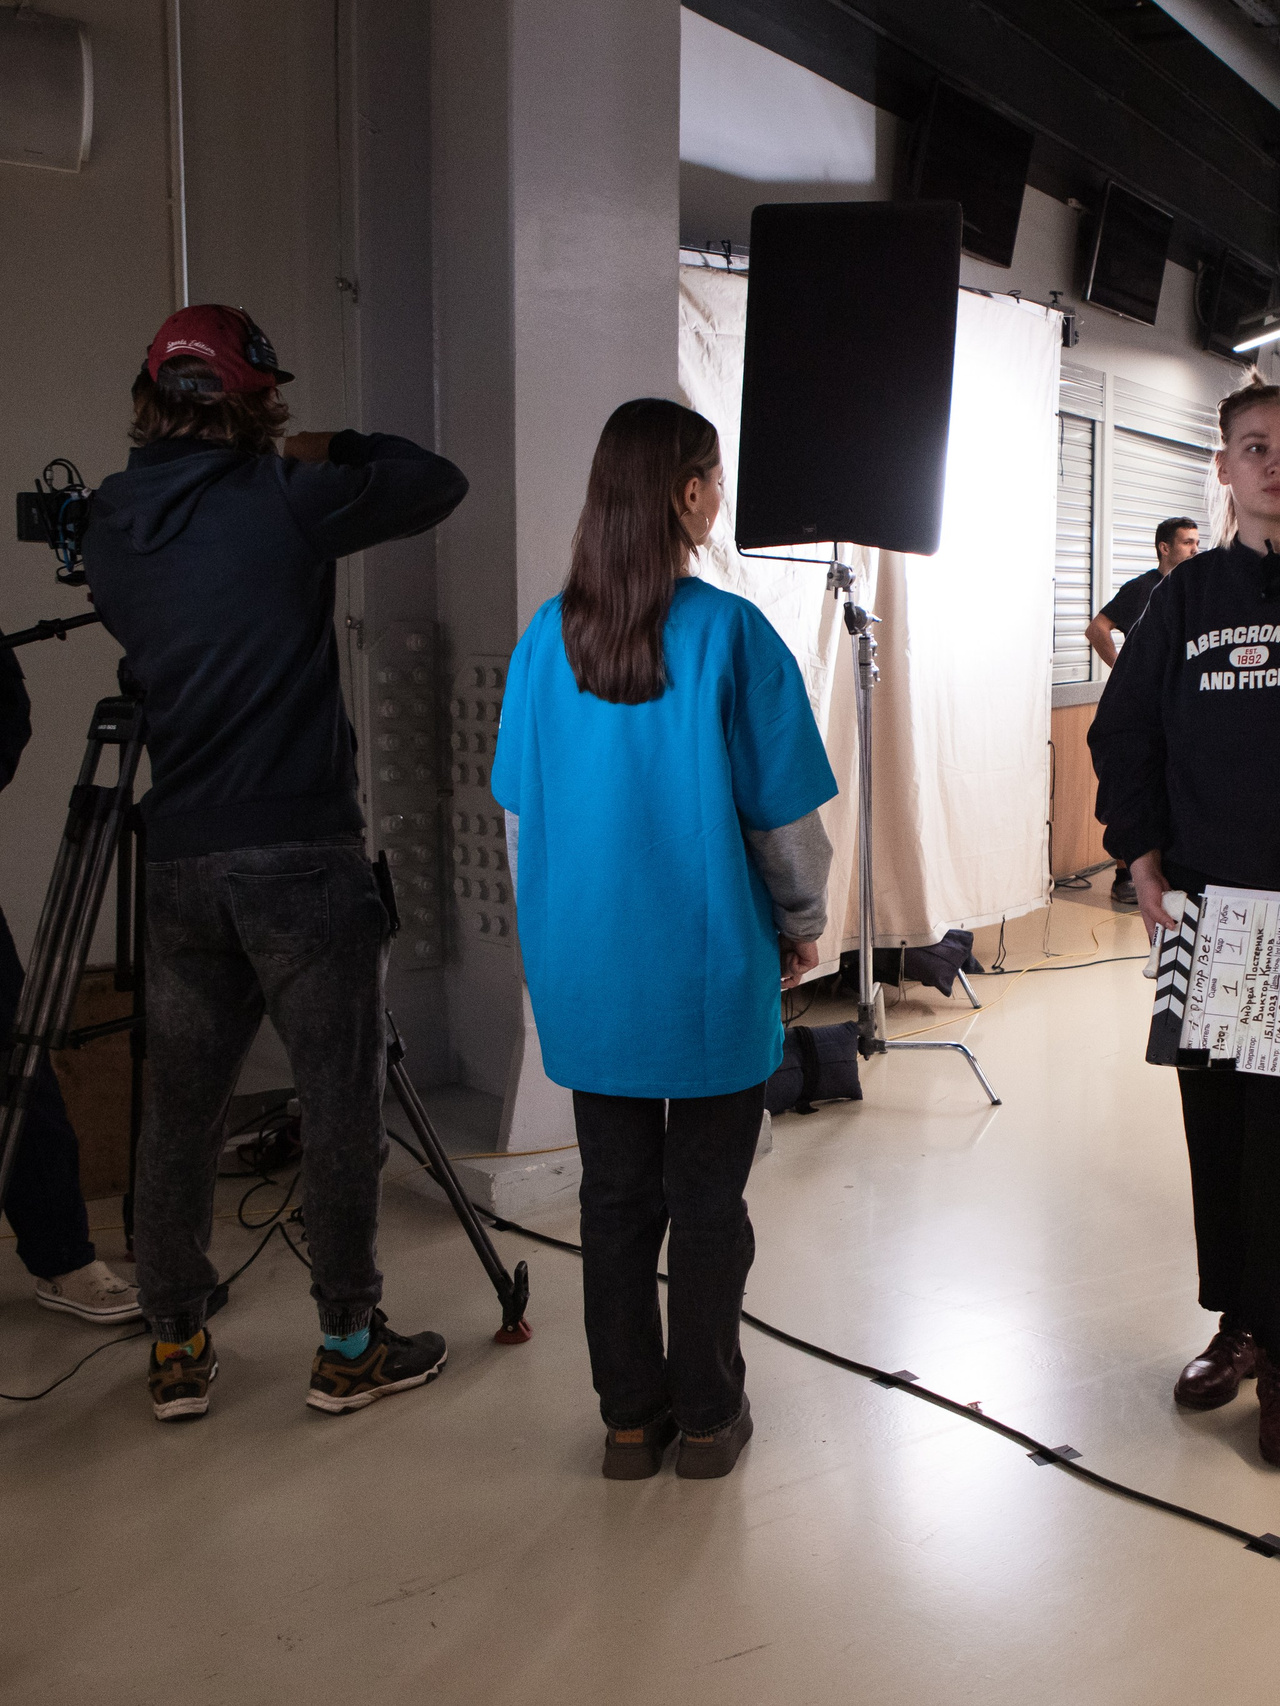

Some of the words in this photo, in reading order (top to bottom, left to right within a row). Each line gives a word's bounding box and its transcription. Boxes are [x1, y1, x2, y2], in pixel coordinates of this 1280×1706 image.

[188, 340, 216, 354] Edition
[1237, 654, 1262, 665] 1892
[1199, 671, 1236, 691] AND
[1220, 904, 1229, 925] Дубль
[1232, 909, 1247, 925] 1
[1197, 934, 1212, 966] Bet
[1215, 938, 1225, 954] Кадр
[1226, 936, 1244, 956] 1
[1245, 928, 1264, 981] Постернак
[1258, 938, 1275, 977] Крылов
[1208, 978, 1218, 999] Сцена
[1222, 980, 1239, 997] 1
[1240, 986, 1256, 1025] Андрей
[1252, 980, 1270, 1022] Виктор
[1264, 995, 1278, 1040] 15.11.2023
[1245, 1036, 1257, 1070] Оператор:
